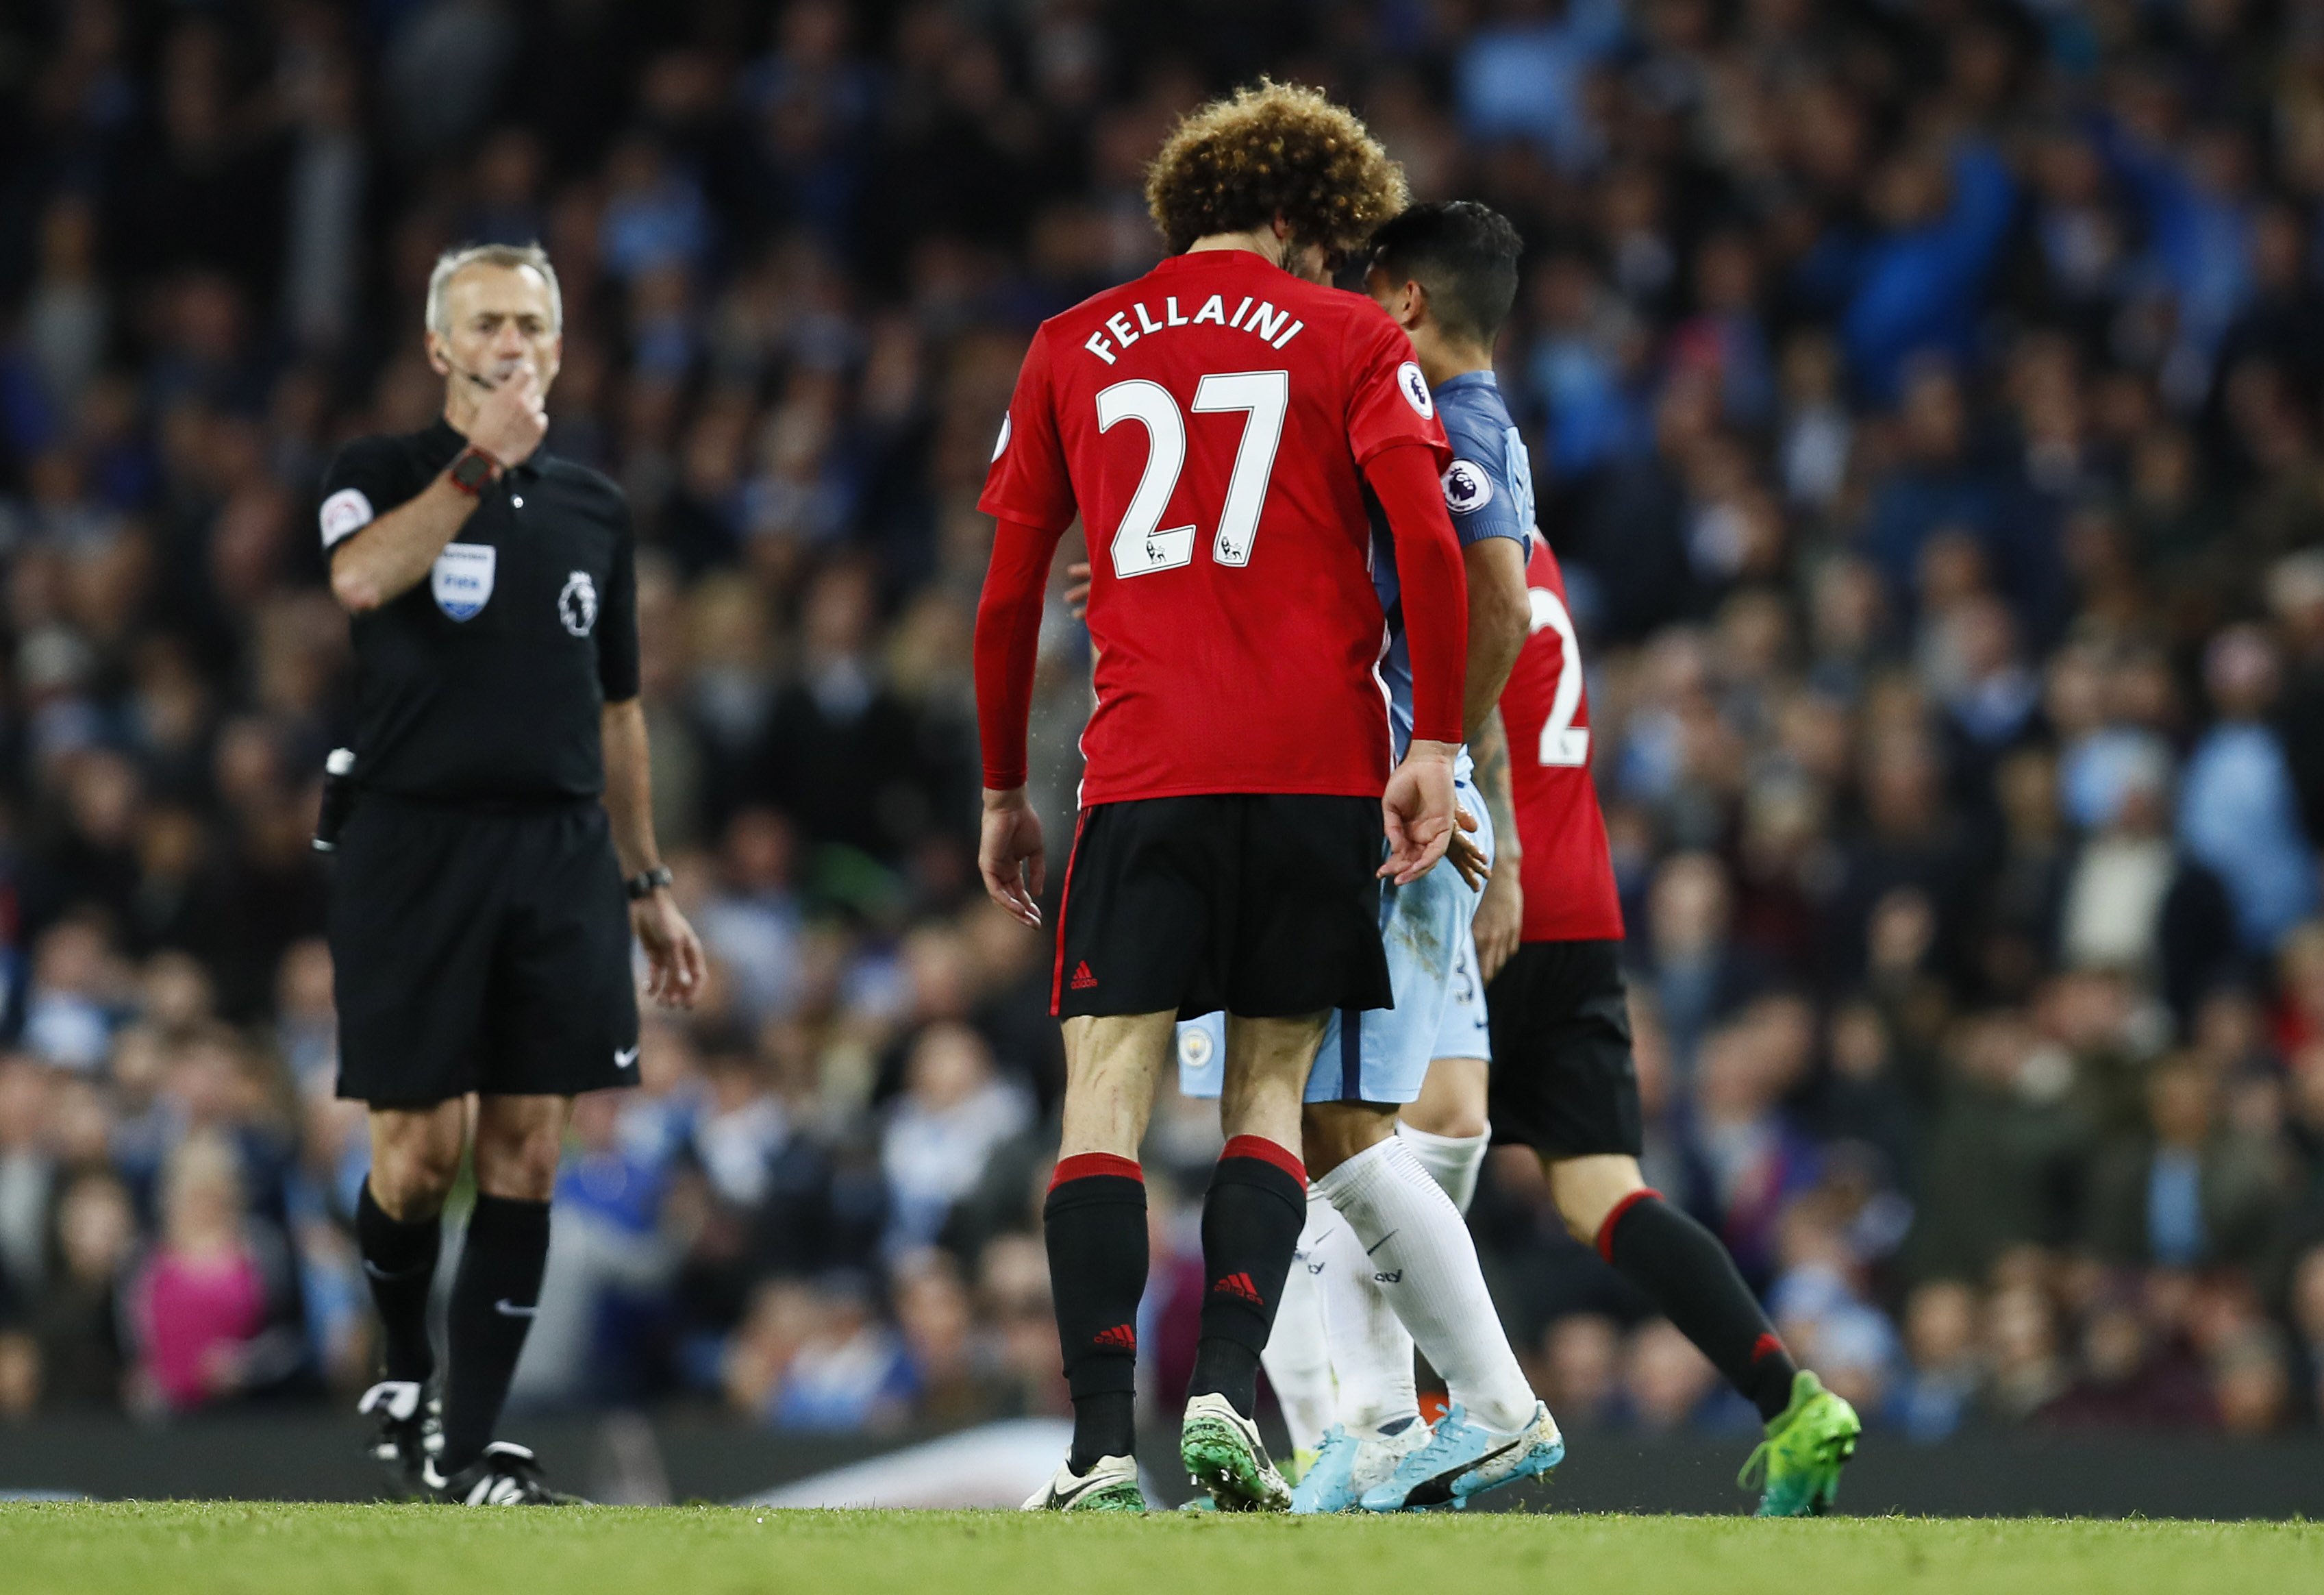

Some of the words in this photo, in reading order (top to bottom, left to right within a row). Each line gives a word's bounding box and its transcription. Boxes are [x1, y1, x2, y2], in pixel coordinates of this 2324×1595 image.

[1085, 295, 1303, 365] FELLAINI
[1095, 369, 1289, 580] 27
[1071, 978, 1099, 989] adidas
